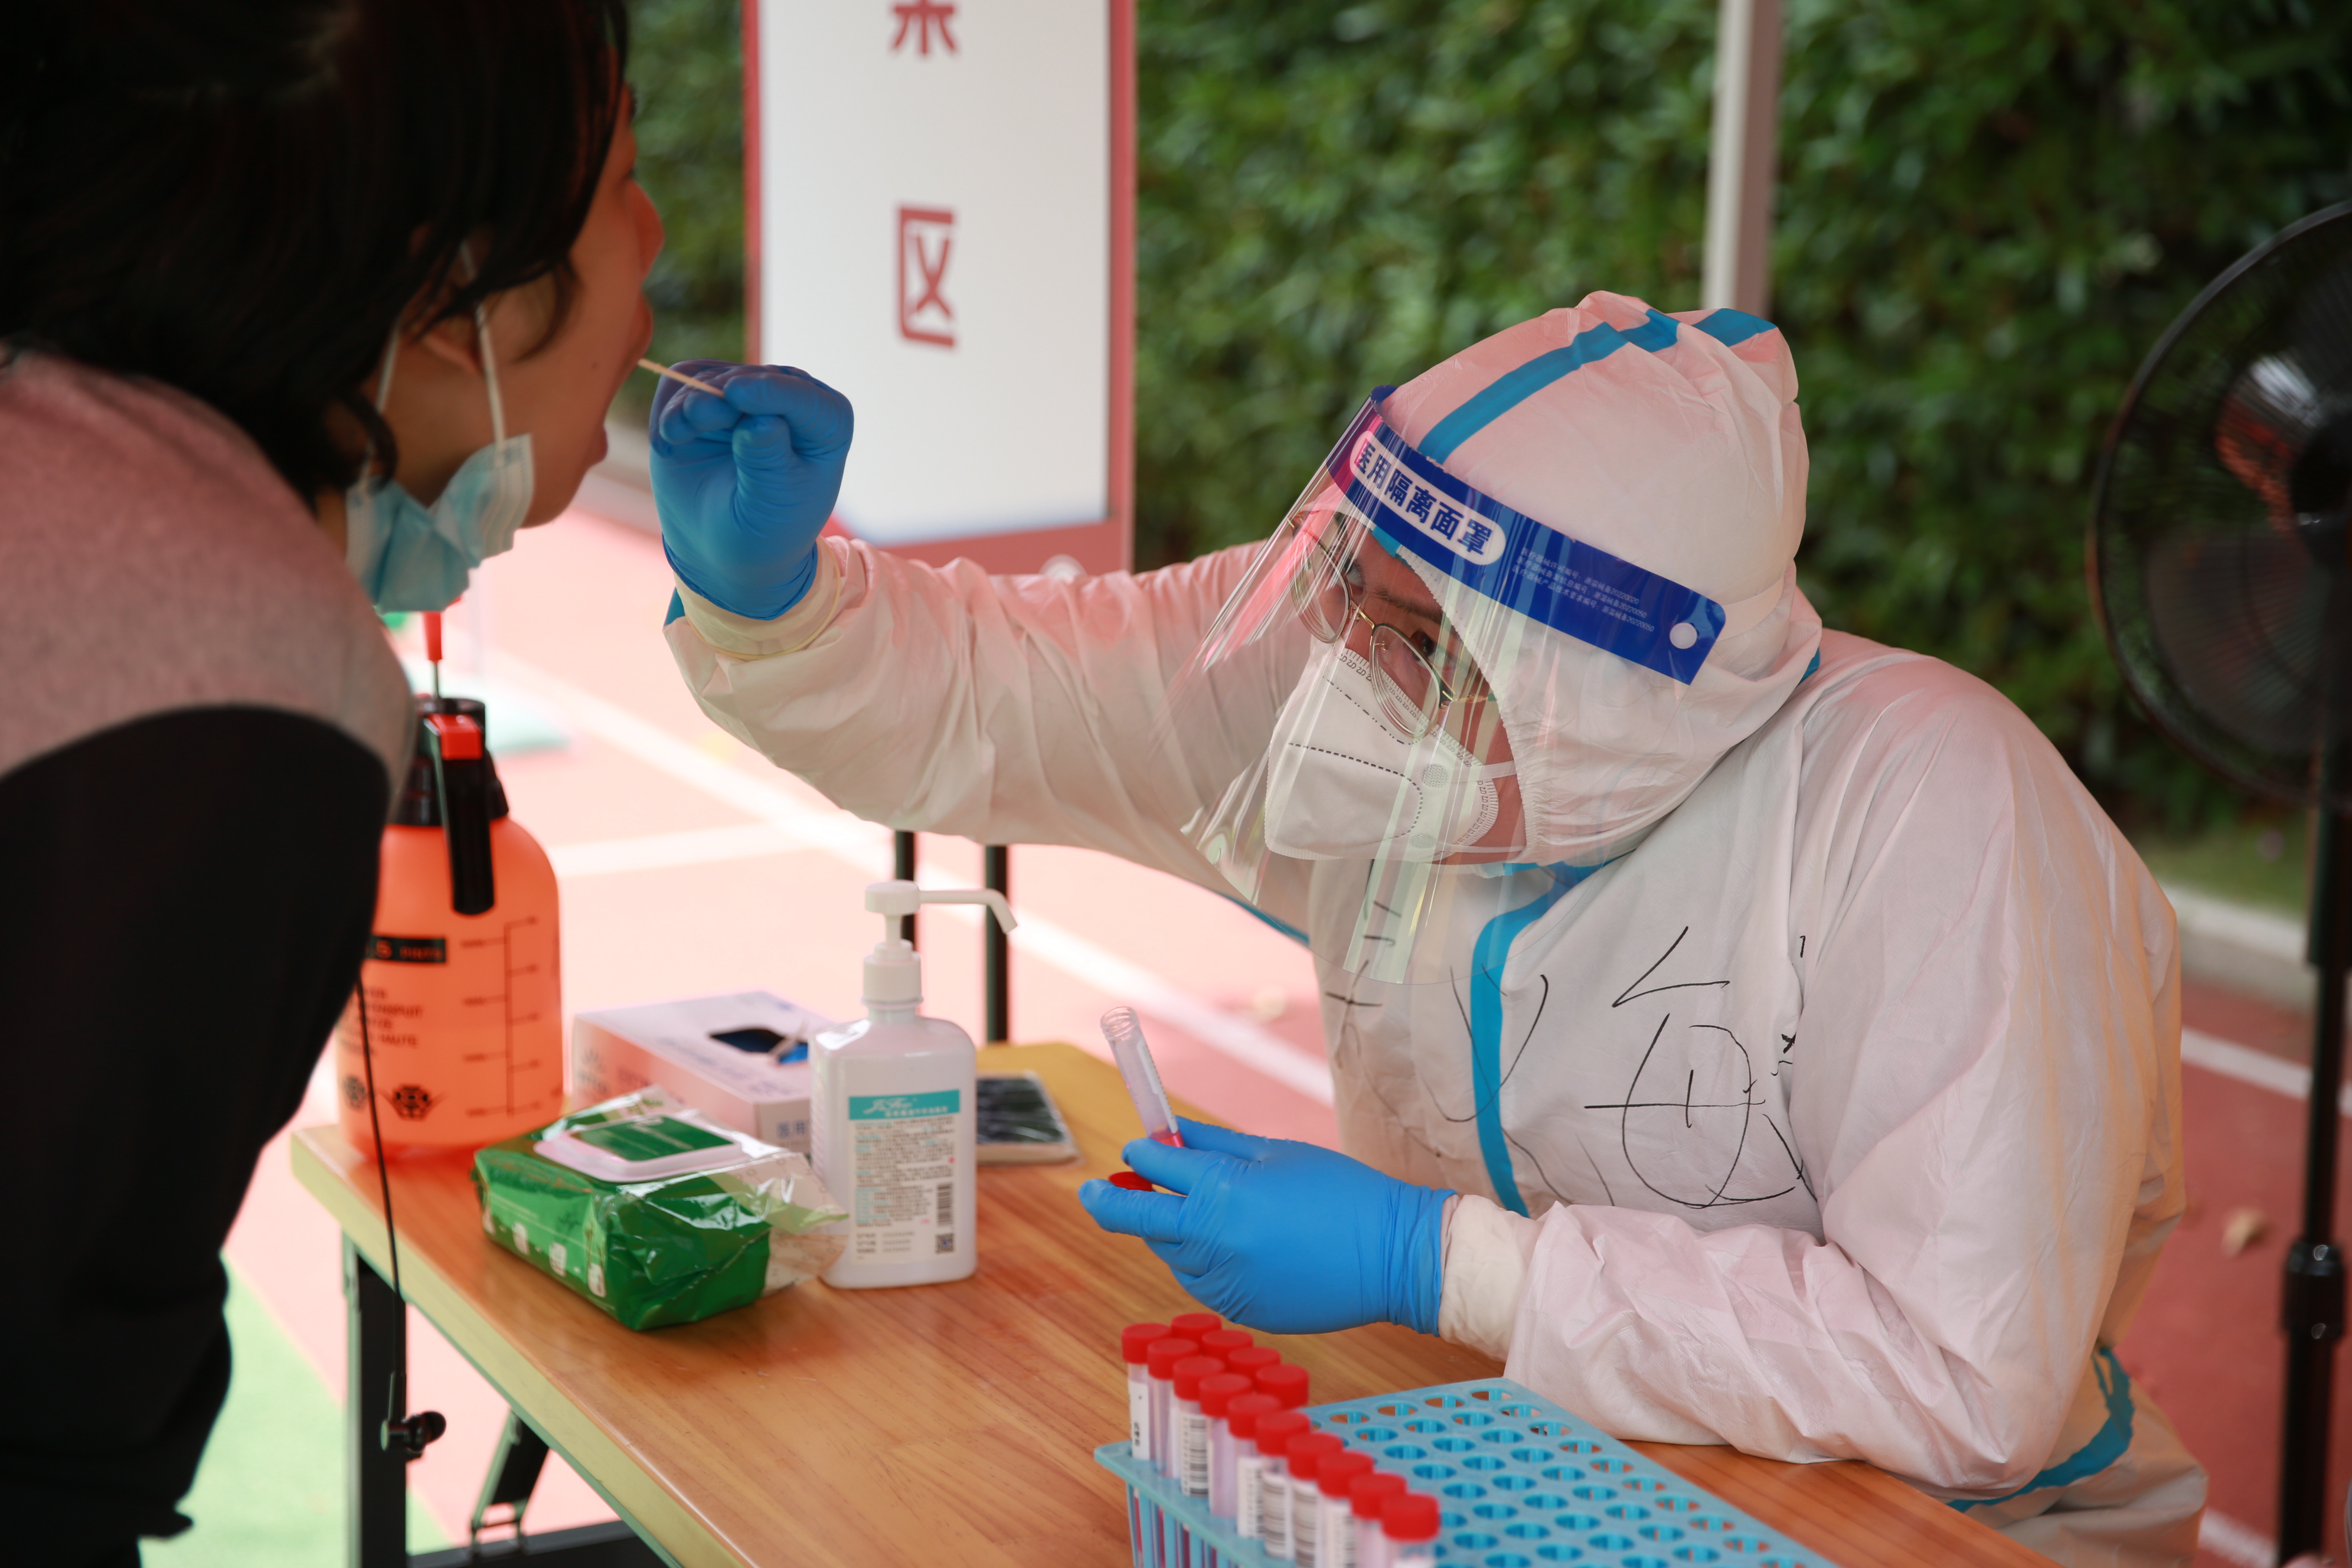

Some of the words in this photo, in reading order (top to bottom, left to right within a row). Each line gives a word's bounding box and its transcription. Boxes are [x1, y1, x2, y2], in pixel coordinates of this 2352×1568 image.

[1354, 438, 1493, 555] 医用隔离面罩
